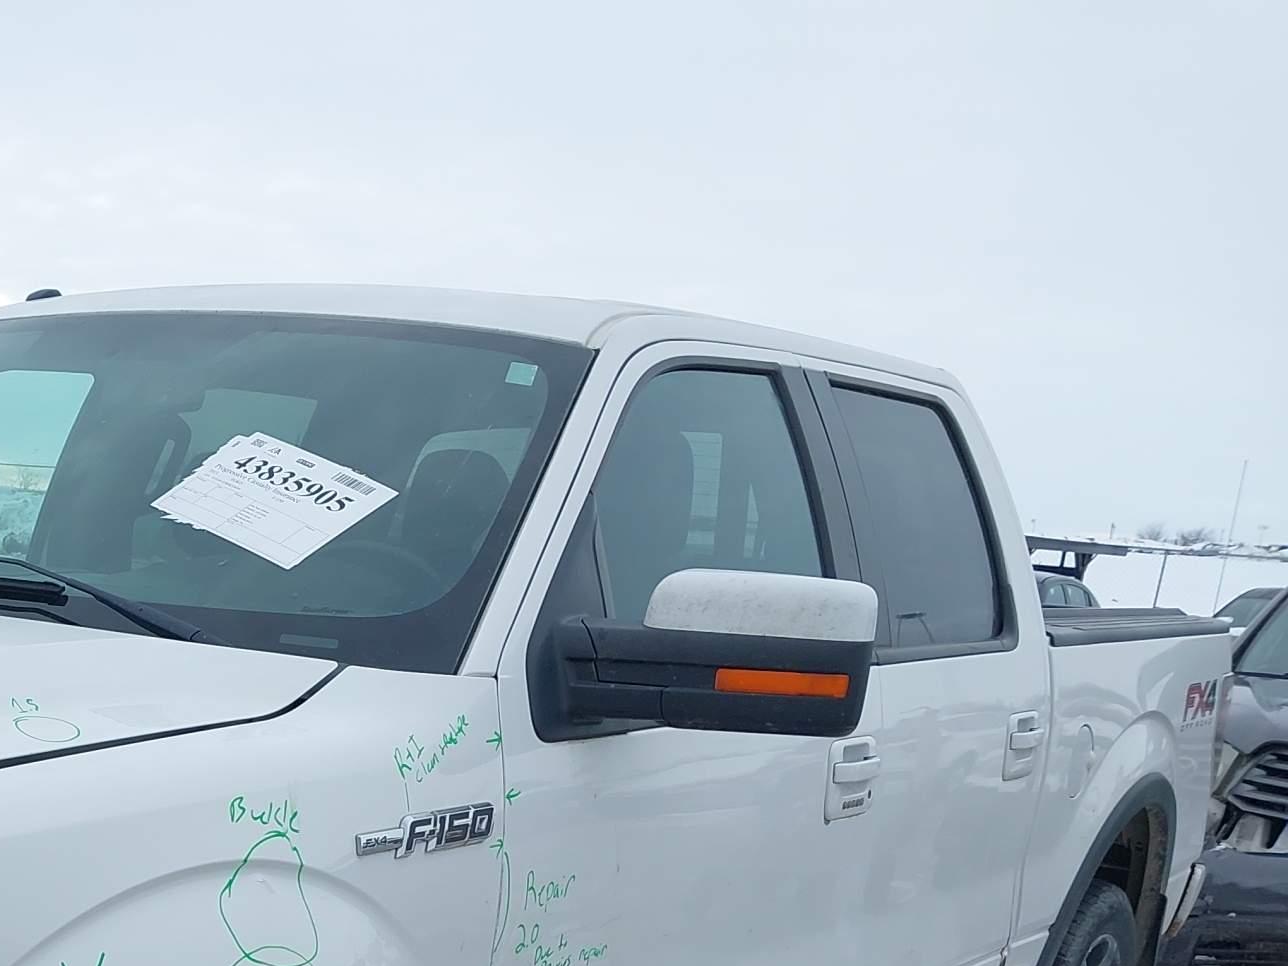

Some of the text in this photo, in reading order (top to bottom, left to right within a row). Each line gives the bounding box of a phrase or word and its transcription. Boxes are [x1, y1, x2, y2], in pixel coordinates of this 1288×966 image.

[233, 455, 356, 512] 43835905
[1182, 679, 1218, 722] FX4
[524, 869, 576, 913] Repair
